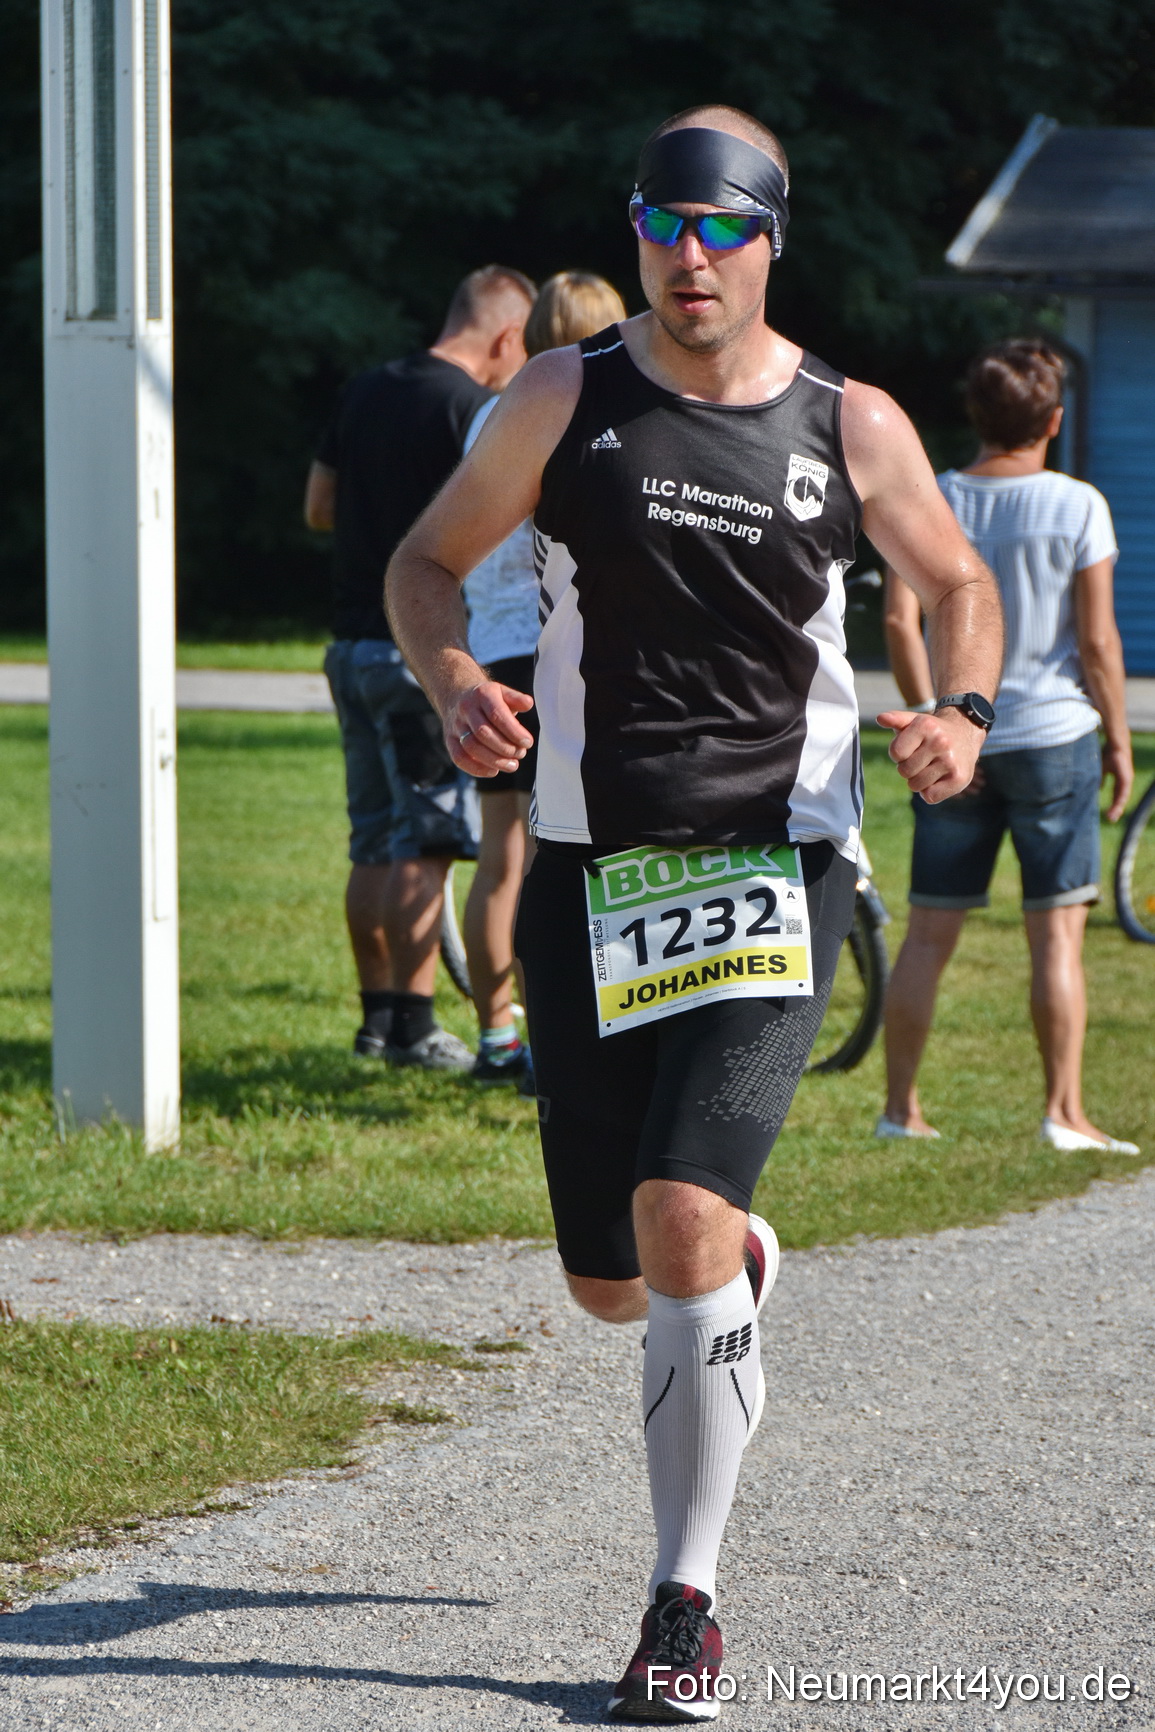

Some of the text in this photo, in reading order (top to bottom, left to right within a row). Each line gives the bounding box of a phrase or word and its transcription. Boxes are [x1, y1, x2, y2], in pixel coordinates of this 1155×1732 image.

[591, 440, 622, 449] adidas
[642, 477, 773, 519] LLC Marathon
[647, 502, 762, 545] Regensburg
[605, 844, 784, 900] BOCK
[786, 891, 796, 900] A
[619, 887, 781, 967] 1232
[619, 954, 788, 1010] JOHANNES
[706, 1346, 750, 1366] cep
